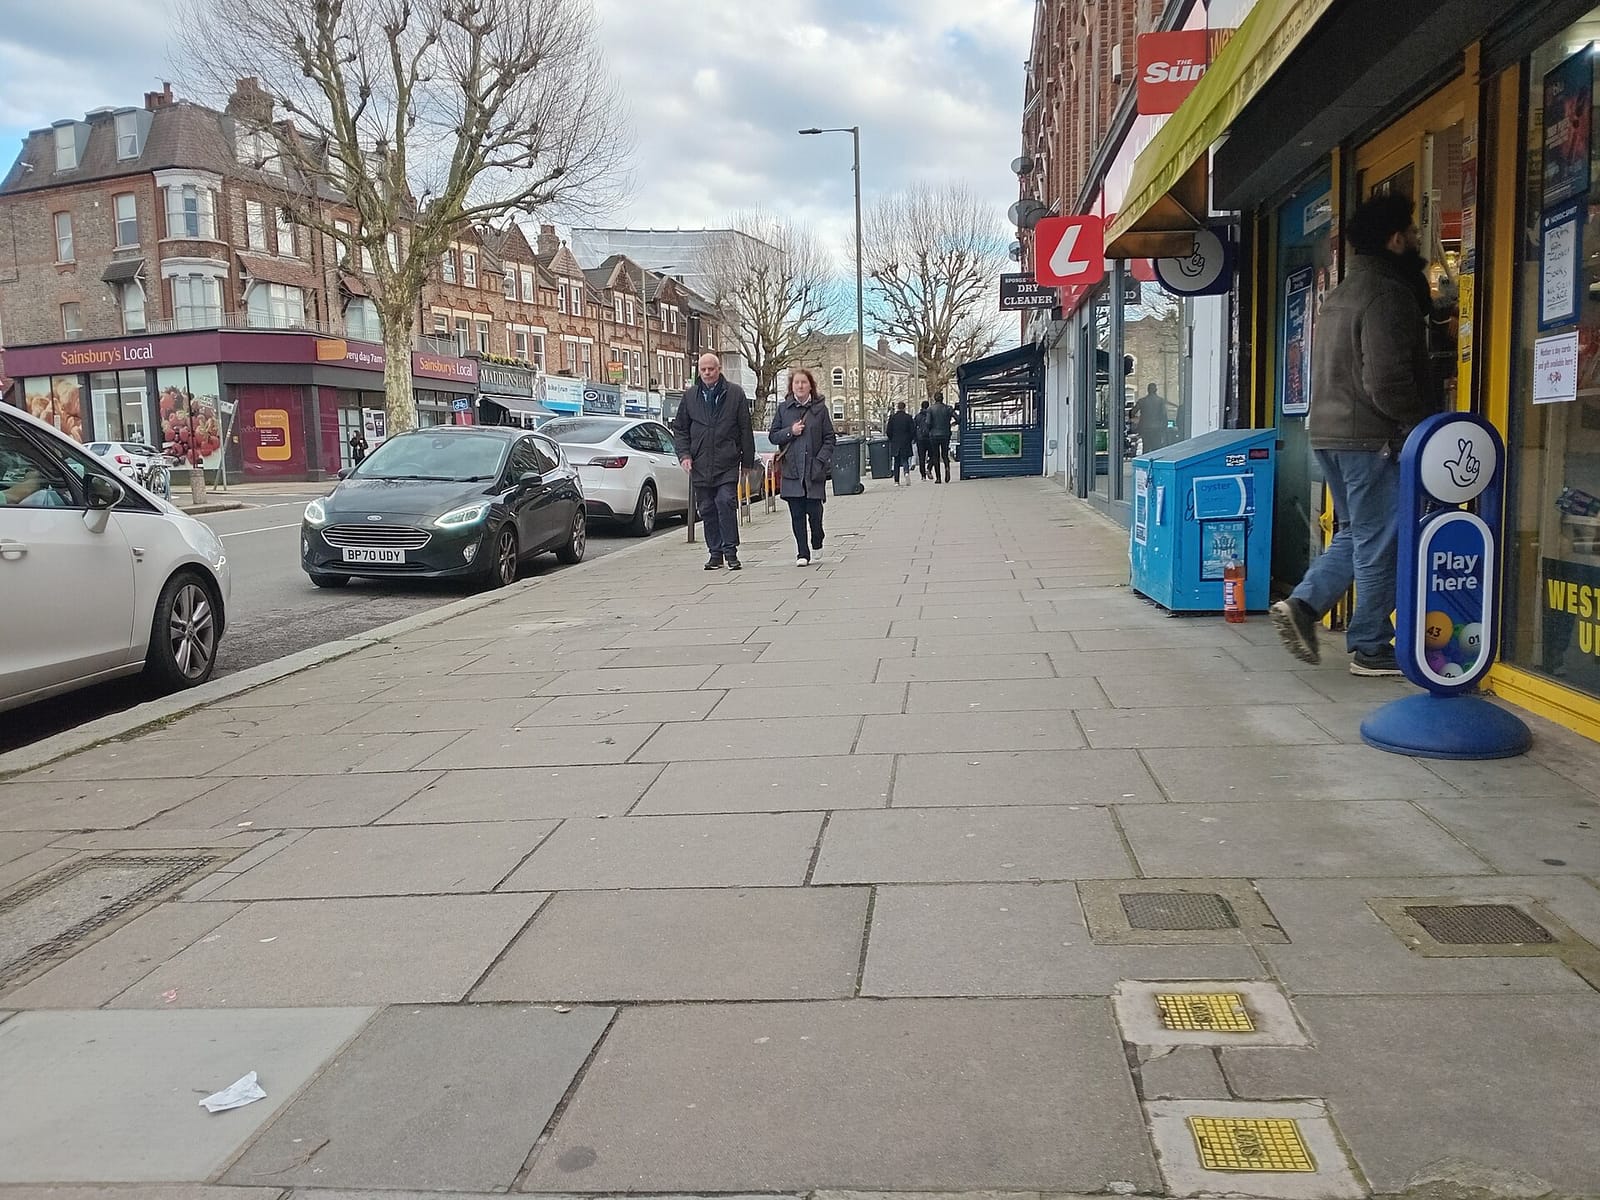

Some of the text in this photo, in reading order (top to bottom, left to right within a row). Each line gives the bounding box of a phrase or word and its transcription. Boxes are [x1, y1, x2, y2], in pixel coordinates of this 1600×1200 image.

[1144, 61, 1207, 84] Sun
[1017, 284, 1039, 292] DRY
[1003, 296, 1052, 305] CLEANER
[61, 343, 154, 366] Sainsbury's Local
[359, 352, 370, 364] day
[420, 357, 473, 376] Sainsbury's Local
[1201, 483, 1232, 492] oyster
[348, 550, 400, 561] BP70 UDY
[1432, 552, 1478, 574] Play
[1432, 574, 1478, 592] here
[1427, 626, 1441, 637] 43
[1468, 634, 1480, 645] 01
